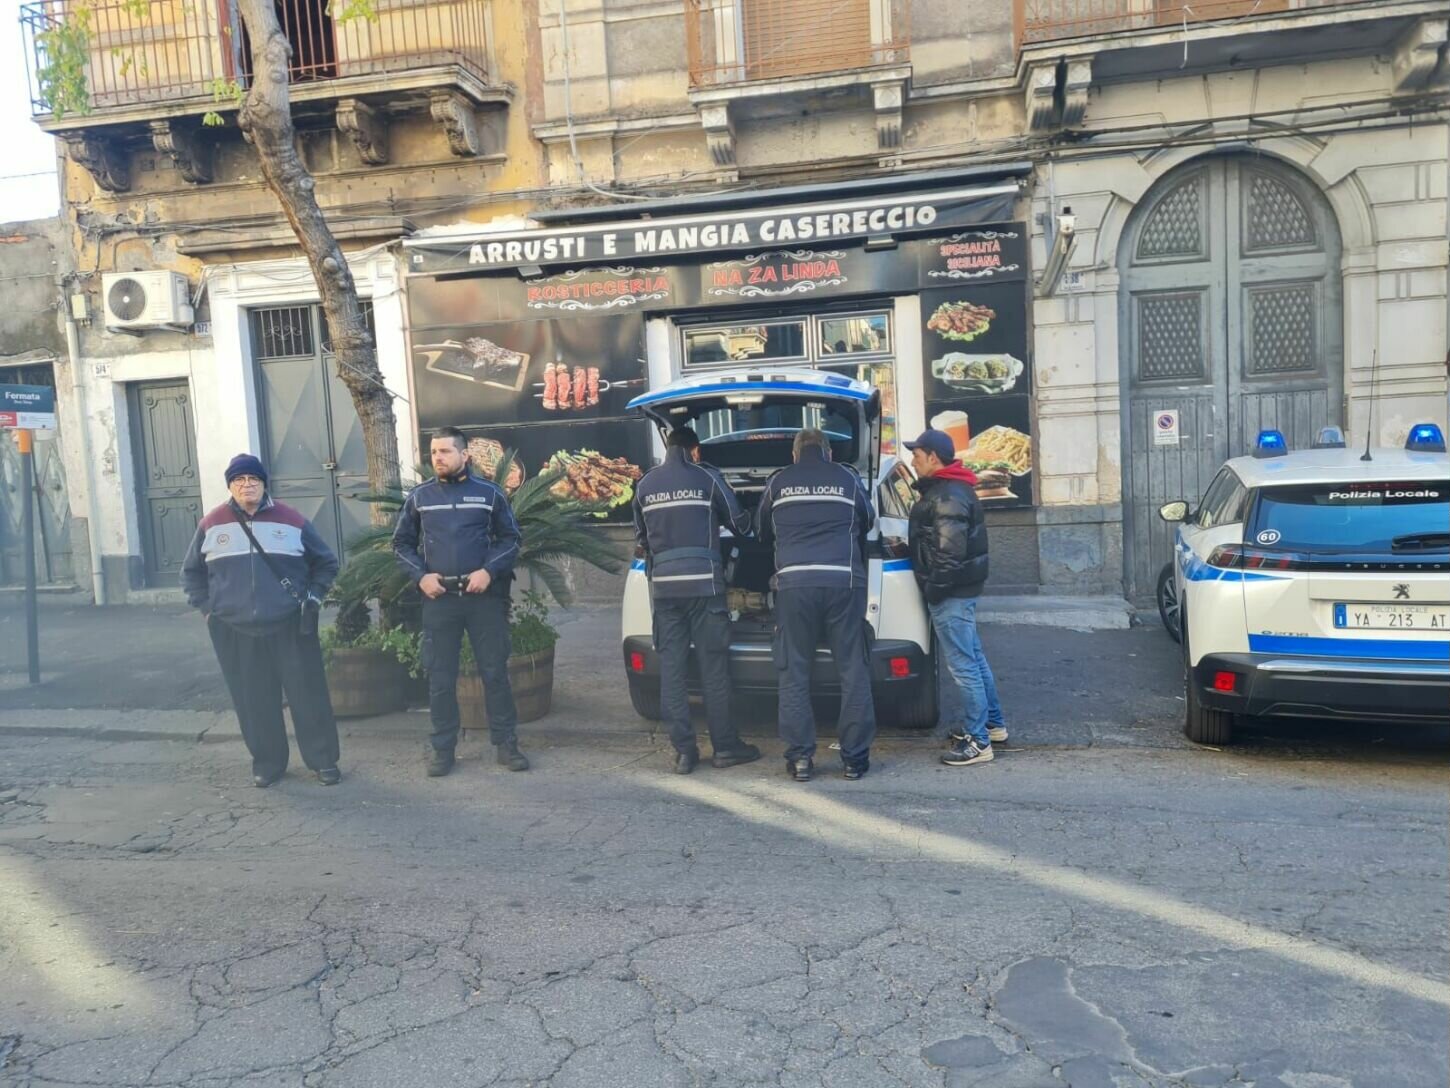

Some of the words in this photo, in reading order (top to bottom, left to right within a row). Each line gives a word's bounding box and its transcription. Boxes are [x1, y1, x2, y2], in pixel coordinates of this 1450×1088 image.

[468, 237, 586, 265] ARRUSTI
[603, 234, 617, 256] E
[634, 221, 749, 253] MANGIA
[759, 205, 938, 242] CASERECCIO
[712, 268, 743, 287] NA
[748, 265, 778, 284] ZA
[781, 259, 842, 282] LINDA
[527, 276, 670, 301] ROSTICCERIA
[5, 392, 40, 400] Fermata
[645, 491, 671, 502] POLIZIA
[672, 489, 704, 500] LOCALE
[780, 486, 810, 497] POLIZIA
[812, 485, 845, 497] LOCALE
[1329, 490, 1381, 500] Polizia
[1385, 490, 1440, 499] Locale
[1260, 532, 1276, 541] 60
[1354, 613, 1371, 626] YA
[1388, 613, 1414, 627] 213
[1431, 614, 1447, 628] AT
